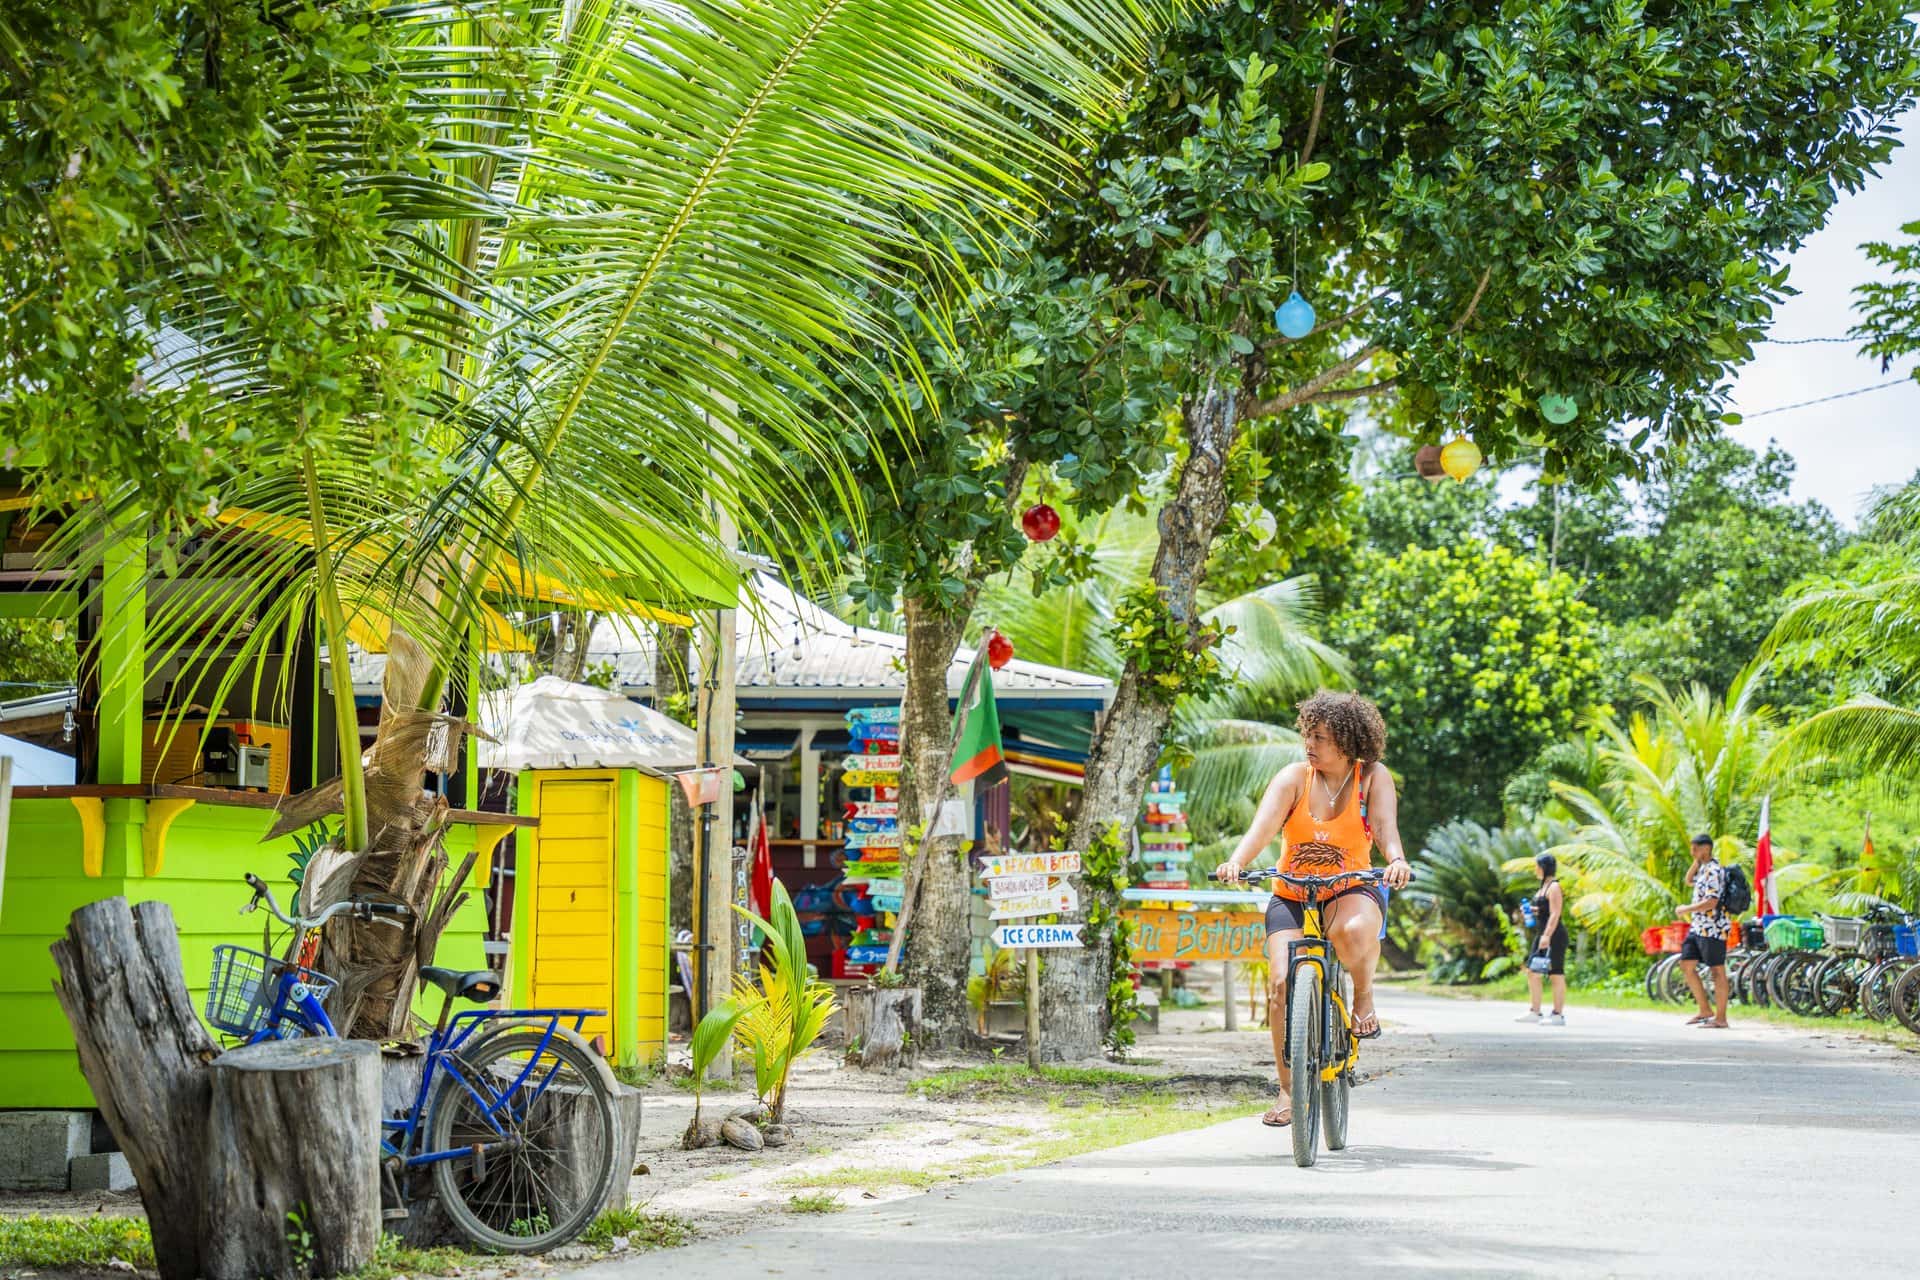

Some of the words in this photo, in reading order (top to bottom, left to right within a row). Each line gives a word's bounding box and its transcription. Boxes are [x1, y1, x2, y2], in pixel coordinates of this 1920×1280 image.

[1050, 853, 1079, 872] BITES
[1003, 928, 1024, 945] ICE
[1028, 928, 1074, 945] CREAM
